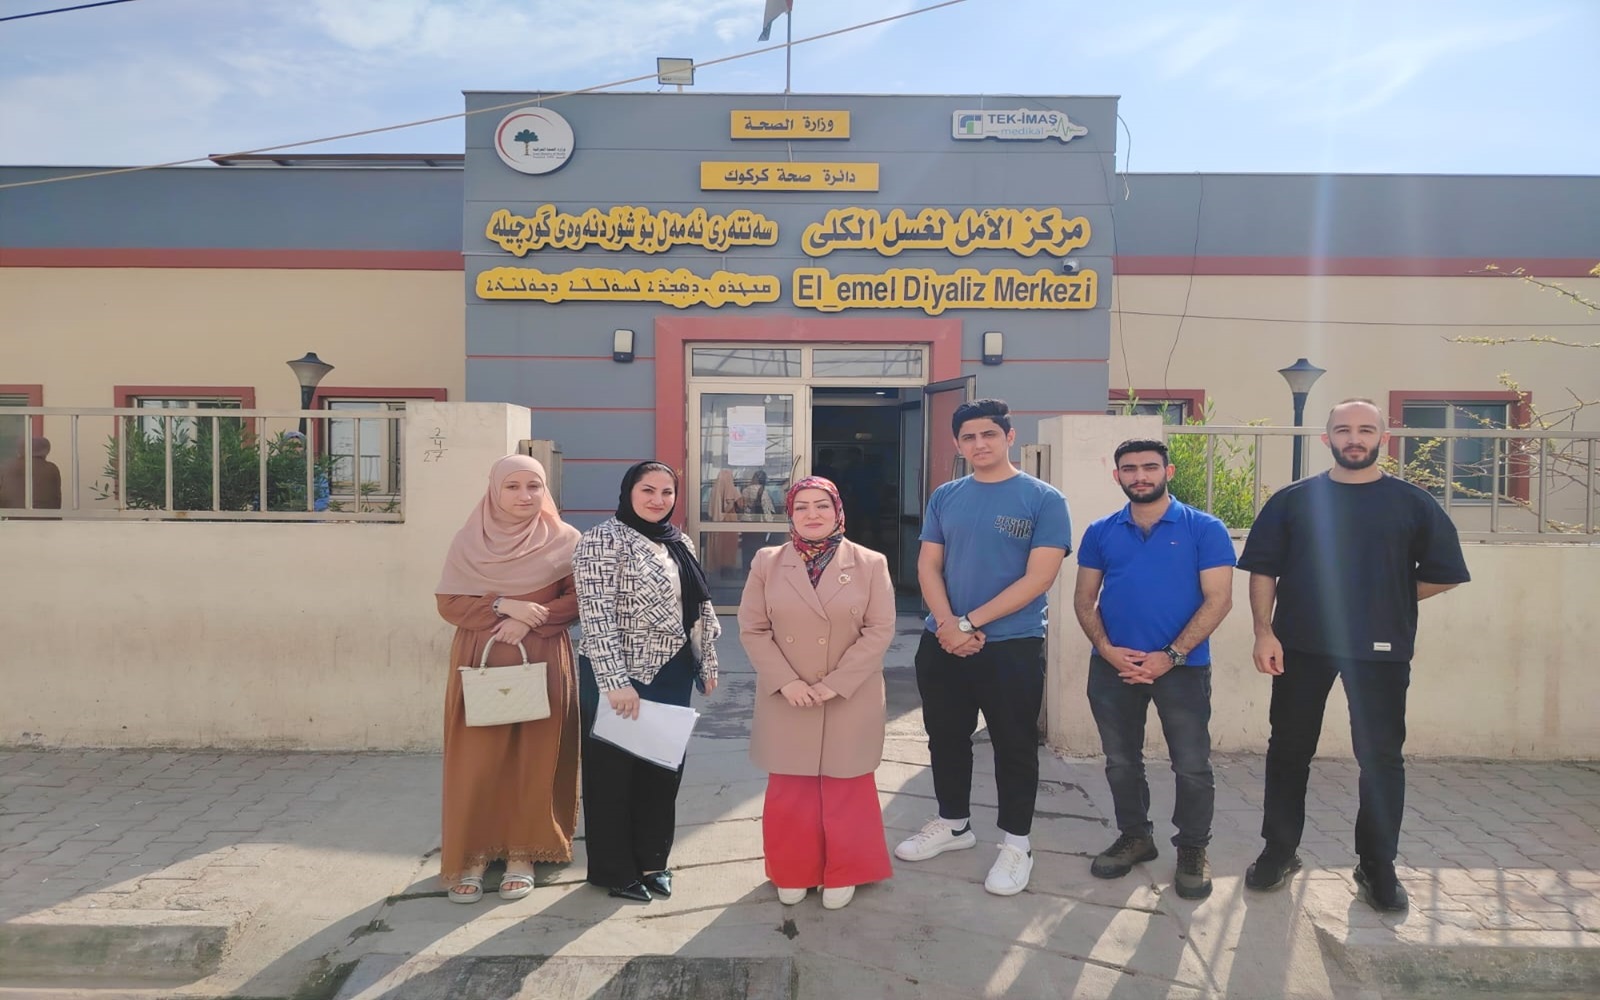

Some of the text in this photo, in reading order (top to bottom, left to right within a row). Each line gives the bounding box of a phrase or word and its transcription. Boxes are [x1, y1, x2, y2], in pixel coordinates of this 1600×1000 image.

[744, 115, 834, 132] وزارة الصحة
[988, 112, 1058, 126] TEK-İMAŞ
[1000, 126, 1044, 136] medikal
[724, 167, 856, 186] دائرة صحة كركوك
[882, 214, 948, 248] لغسل
[955, 211, 1014, 247] الأمل
[1019, 214, 1084, 248] مركز
[798, 274, 1092, 310] El_emel Diyaliz Merkezi
